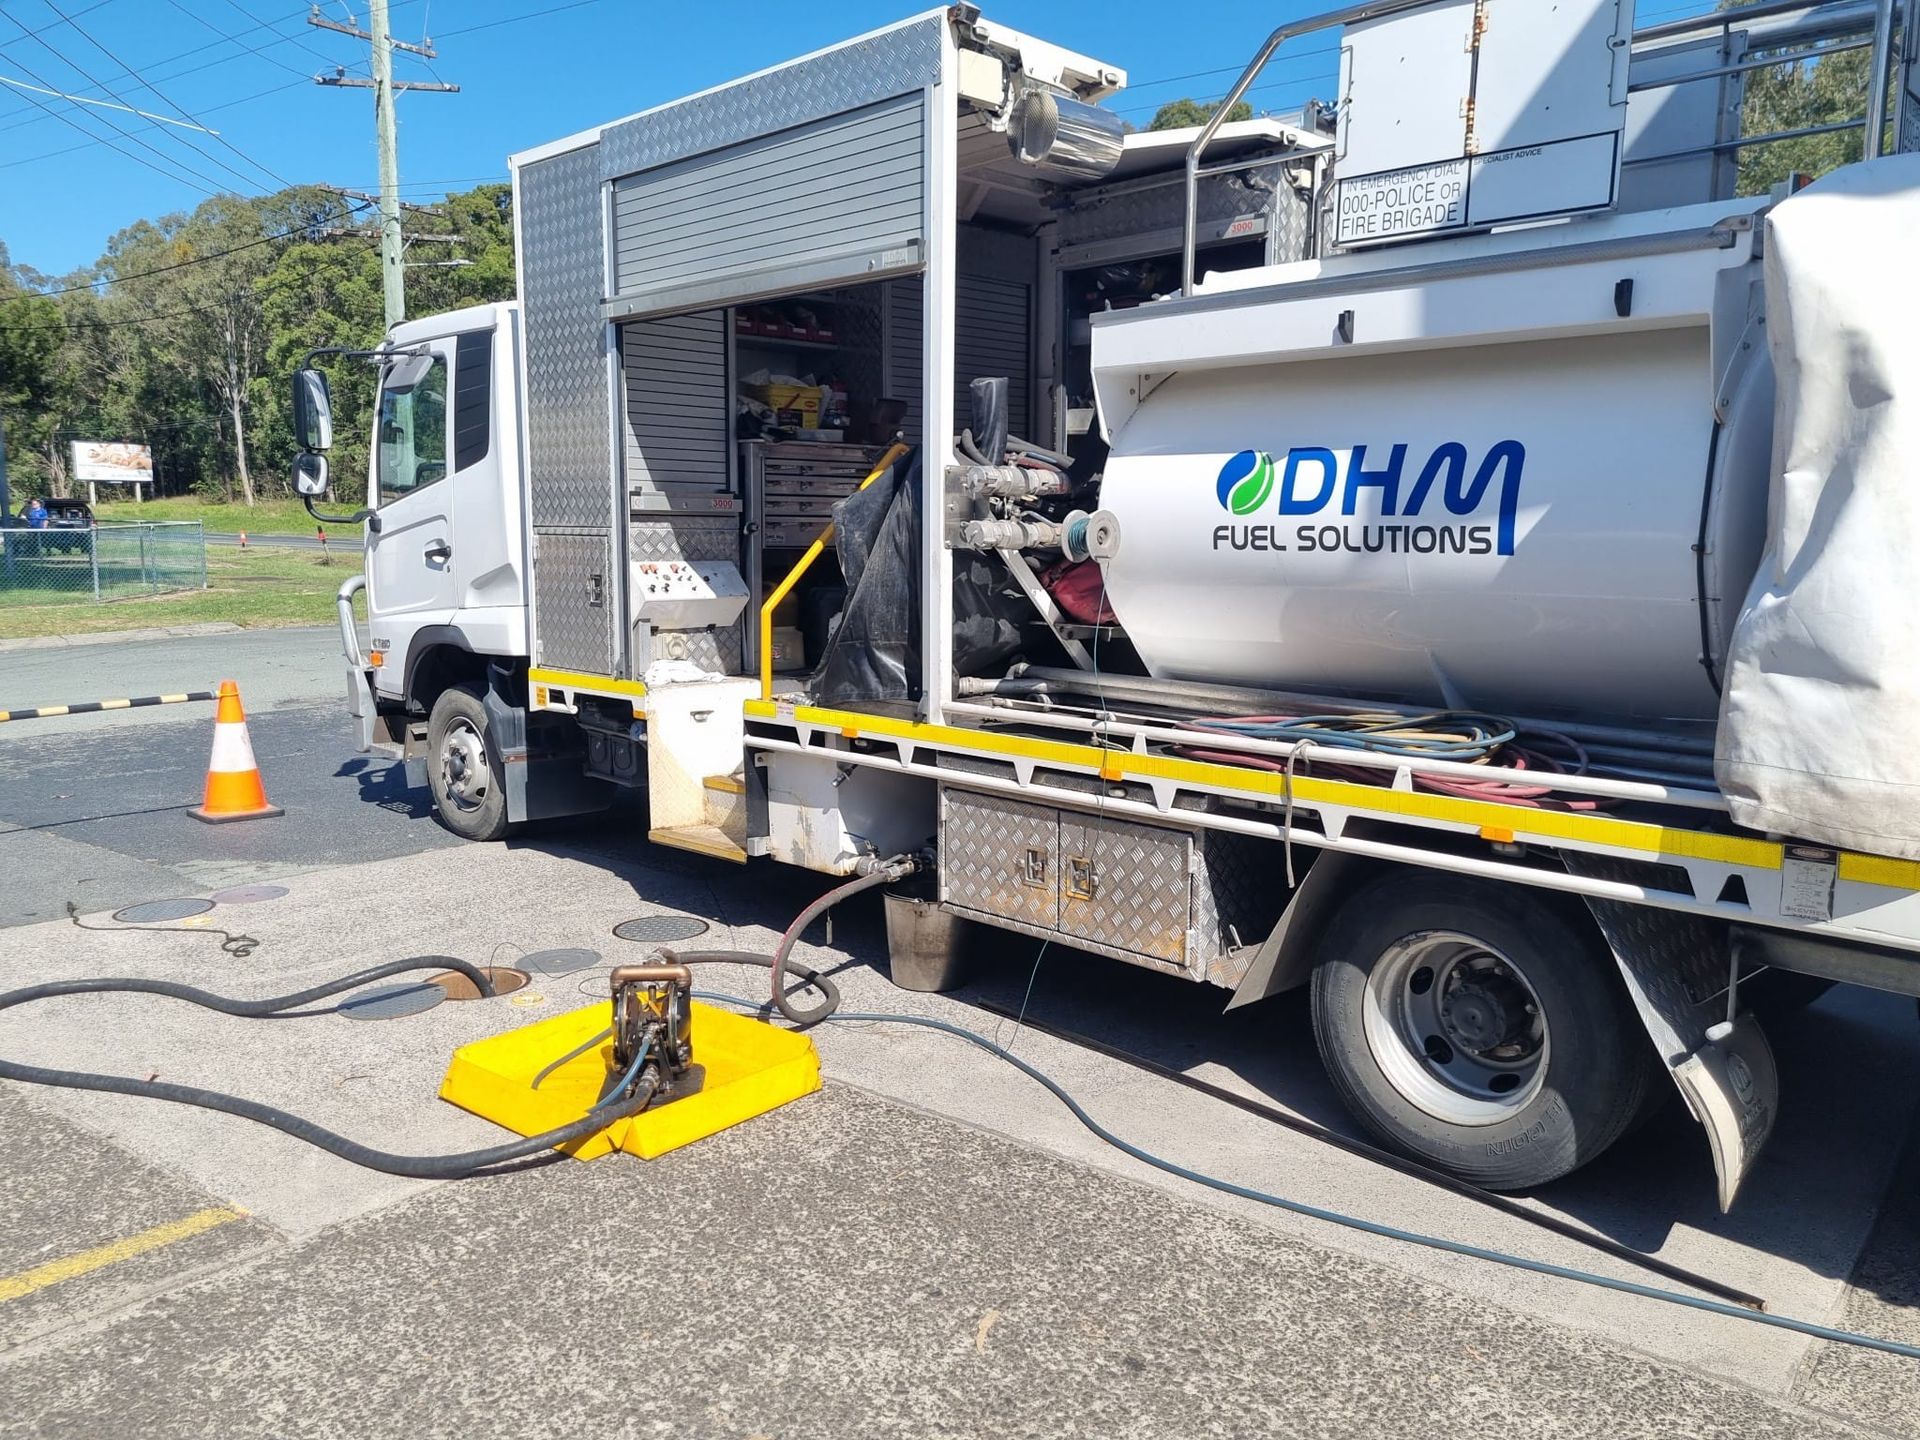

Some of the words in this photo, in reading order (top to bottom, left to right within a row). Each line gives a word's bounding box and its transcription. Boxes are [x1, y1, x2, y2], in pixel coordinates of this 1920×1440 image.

[1474, 152, 1515, 165] SPECIALIST
[1515, 148, 1542, 159] ADVICE
[1347, 180, 1358, 192] IN
[1361, 169, 1430, 191] EMERGENCY
[1434, 162, 1460, 178] DIAL
[1343, 182, 1435, 215] 000-POLICE
[1440, 182, 1461, 200] OR
[1232, 221, 1253, 233] 3000
[1341, 214, 1377, 237] FIRE
[1382, 202, 1458, 231] BRIGADE
[1278, 440, 1526, 556] DHM
[1213, 525, 1287, 551] FUEL
[1296, 525, 1492, 555] SOLUTIONS
